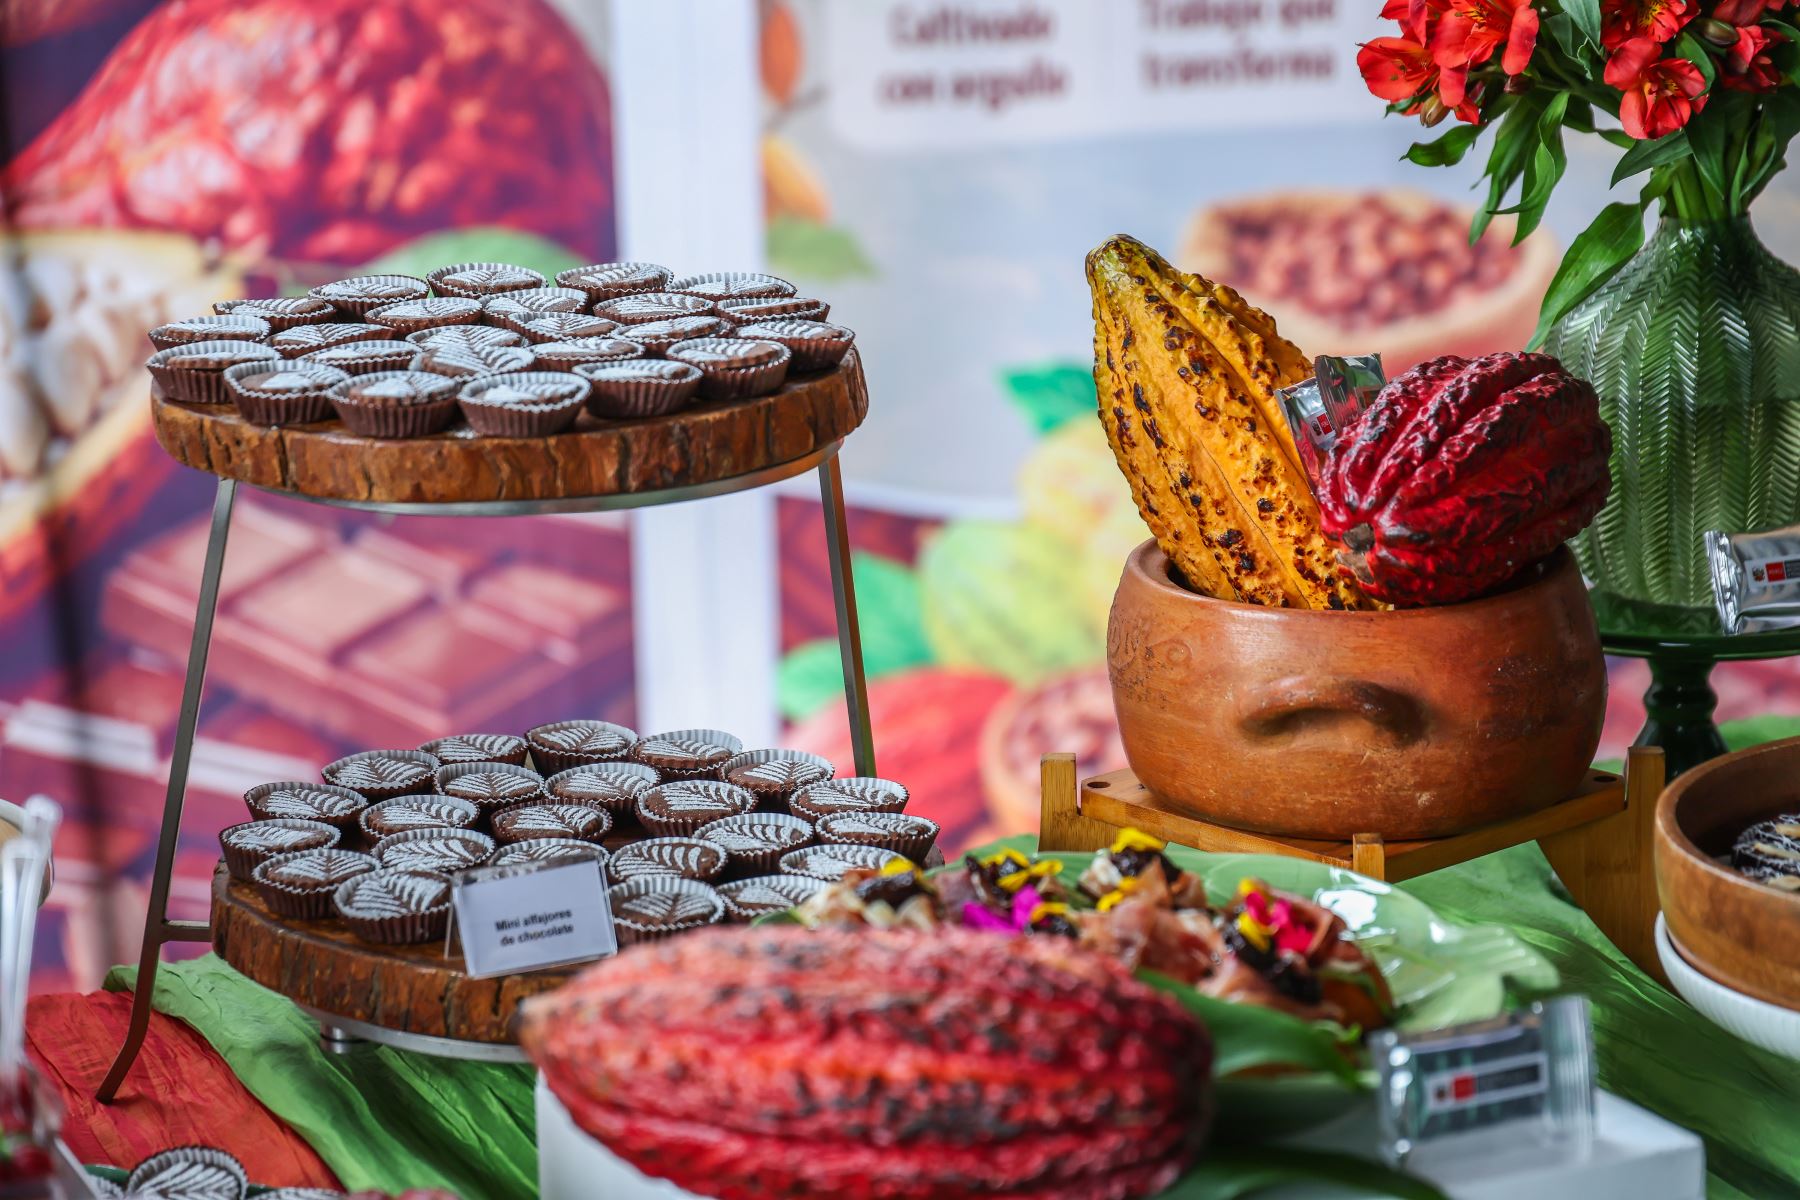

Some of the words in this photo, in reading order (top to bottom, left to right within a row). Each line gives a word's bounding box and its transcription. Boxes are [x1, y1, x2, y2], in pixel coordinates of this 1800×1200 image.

[1143, 47, 1335, 86] transforma
[879, 75, 934, 102] con
[951, 59, 1067, 111] orgullo
[495, 917, 520, 931] Mini
[523, 909, 572, 926] alfajores
[500, 935, 514, 946] de
[518, 924, 573, 943] chocolate
